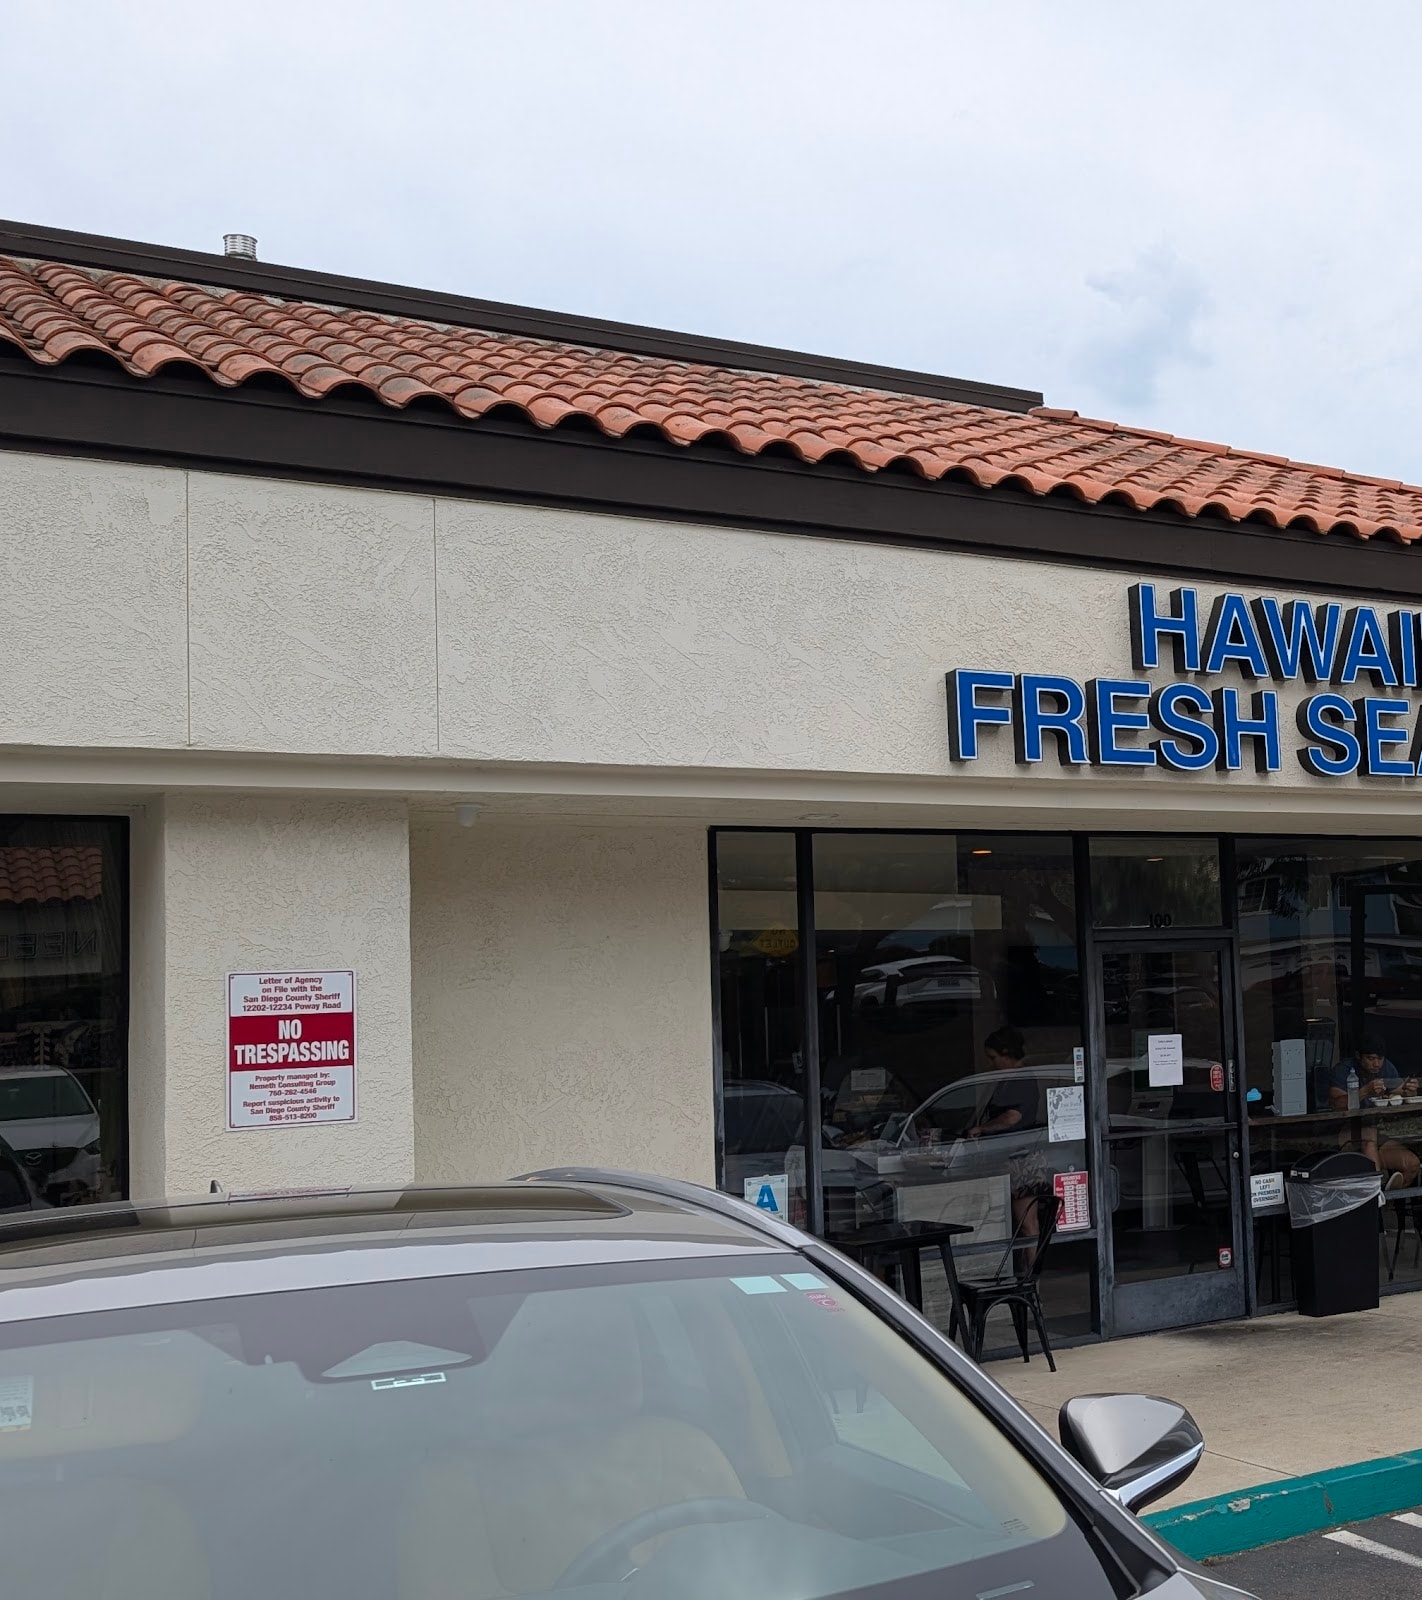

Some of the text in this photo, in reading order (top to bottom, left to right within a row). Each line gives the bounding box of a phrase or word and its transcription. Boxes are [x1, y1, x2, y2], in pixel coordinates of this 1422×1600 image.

[946, 668, 1283, 774] FRESH
[1149, 912, 1172, 928] 100
[259, 977, 282, 985] Letter
[294, 976, 323, 985] Agency
[274, 985, 288, 993] File
[243, 992, 340, 1003] San Diego County Sheriff
[242, 1001, 341, 1012] 12202-12234 Poway Road
[278, 1018, 302, 1040] NO
[234, 1039, 350, 1065] TRESPASSING
[255, 1074, 285, 1082] Property
[249, 1082, 276, 1090] Nemeth
[315, 1079, 336, 1087] Group
[243, 1100, 266, 1108] Report
[268, 1098, 304, 1106] suspicious
[306, 1096, 331, 1104] activity
[265, 1107, 285, 1115] Diego
[287, 1105, 310, 1113] County
[312, 1103, 335, 1111] Sheriff
[1258, 1188, 1281, 1196] PREMISES
[756, 1184, 779, 1212] A
[1253, 1195, 1278, 1203] OVERNIGHT
